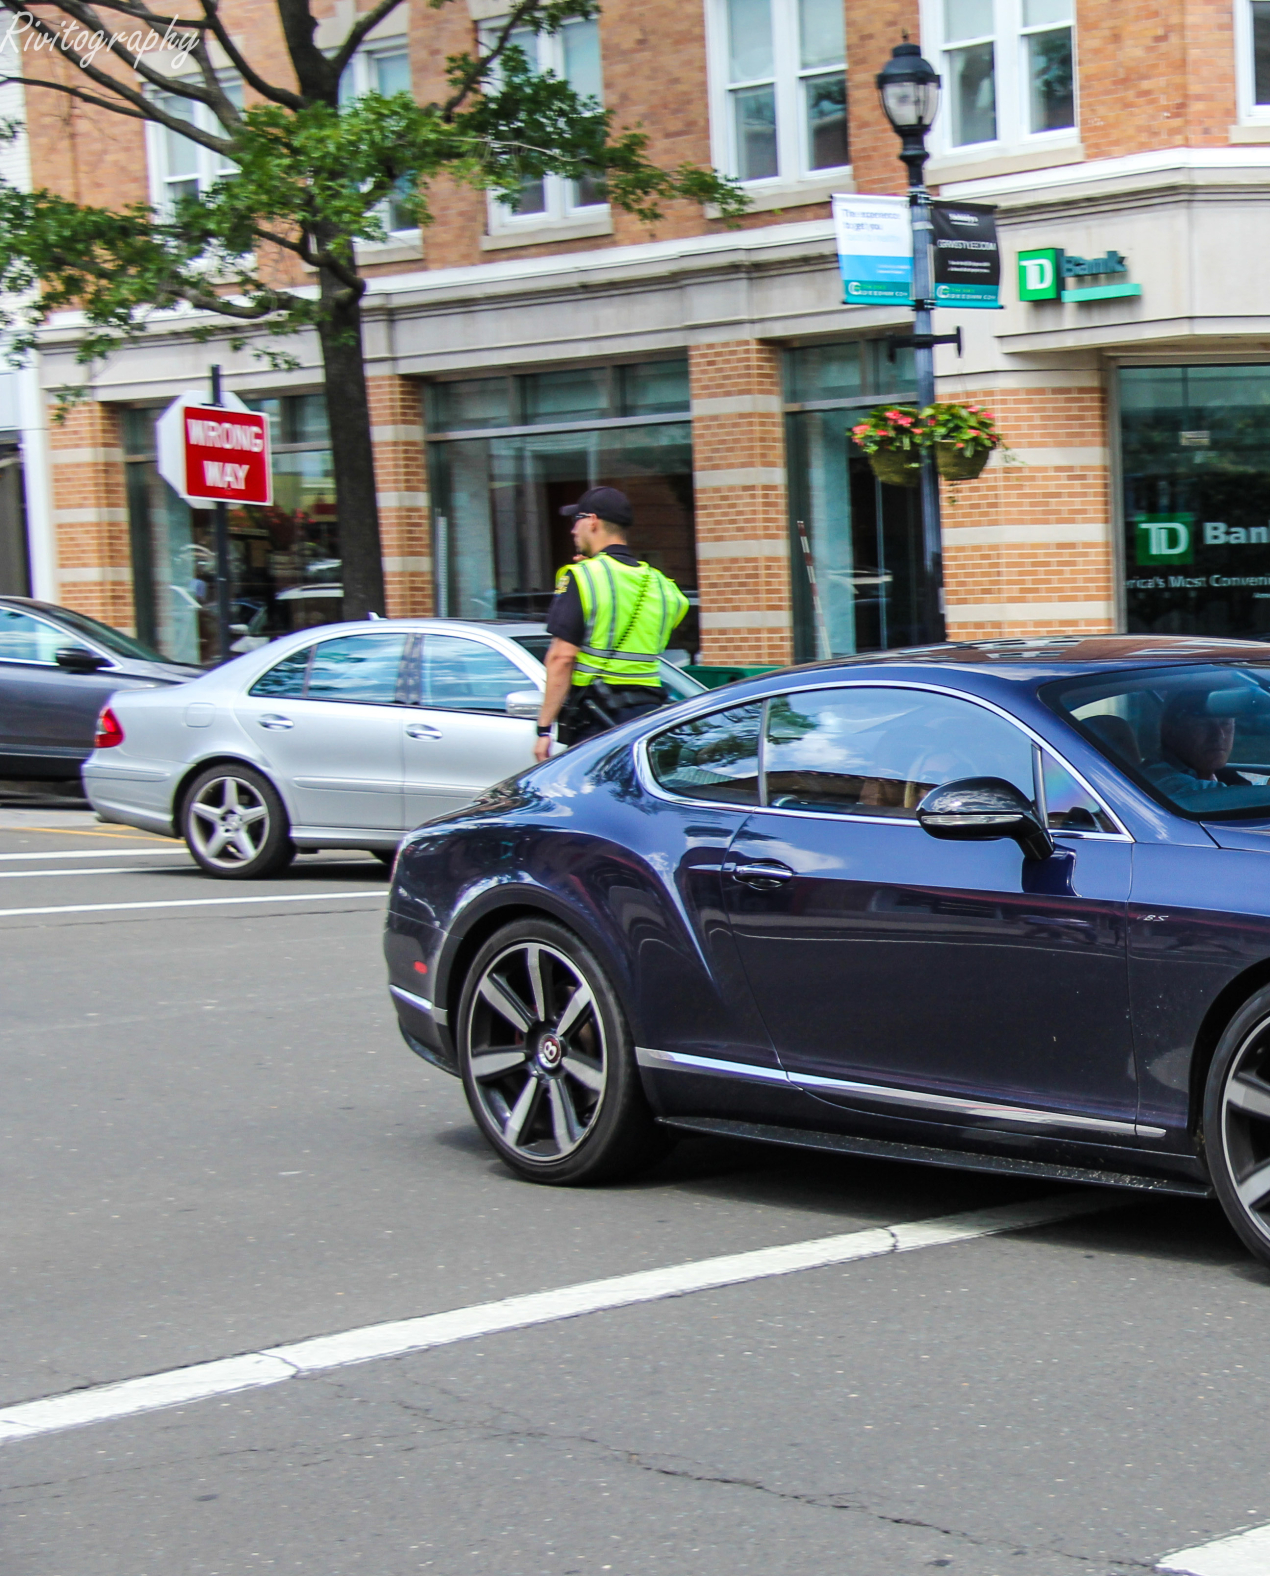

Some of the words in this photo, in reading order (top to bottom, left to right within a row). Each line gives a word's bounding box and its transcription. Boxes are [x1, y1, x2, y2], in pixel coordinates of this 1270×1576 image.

[1020, 258, 1054, 290] TD
[1061, 250, 1128, 278] Bank
[186, 418, 264, 453] WRONG
[203, 460, 250, 490] WAY
[1139, 522, 1189, 555] TD
[1167, 575, 1207, 588] Most
